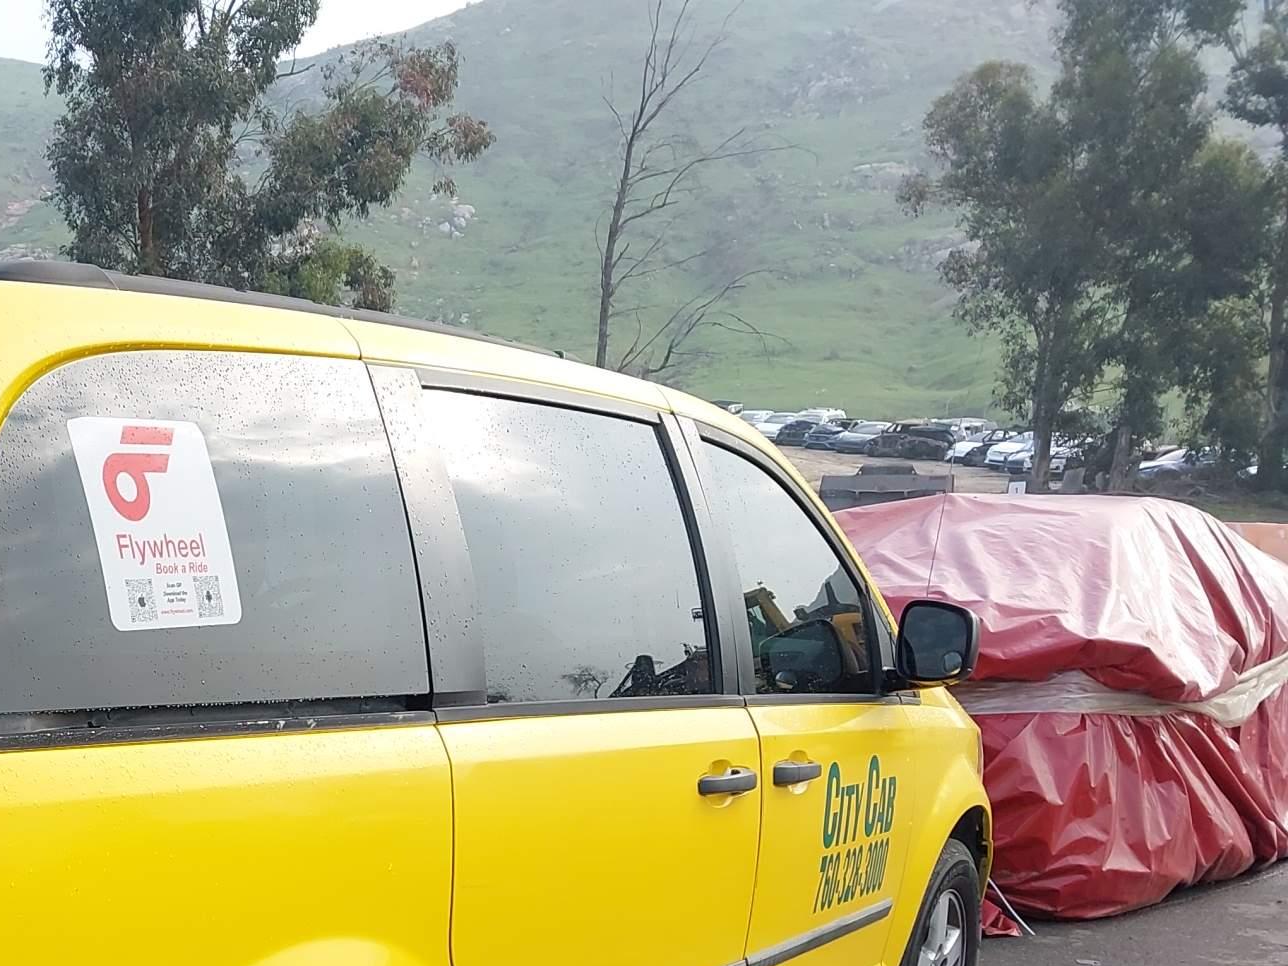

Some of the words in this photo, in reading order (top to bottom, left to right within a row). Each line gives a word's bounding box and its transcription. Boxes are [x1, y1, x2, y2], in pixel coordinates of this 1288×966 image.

[116, 532, 206, 565] Flywheel
[155, 563, 178, 574] Book
[181, 565, 187, 573] a
[188, 562, 208, 573] Ride
[813, 837, 890, 914] 760-328-3000
